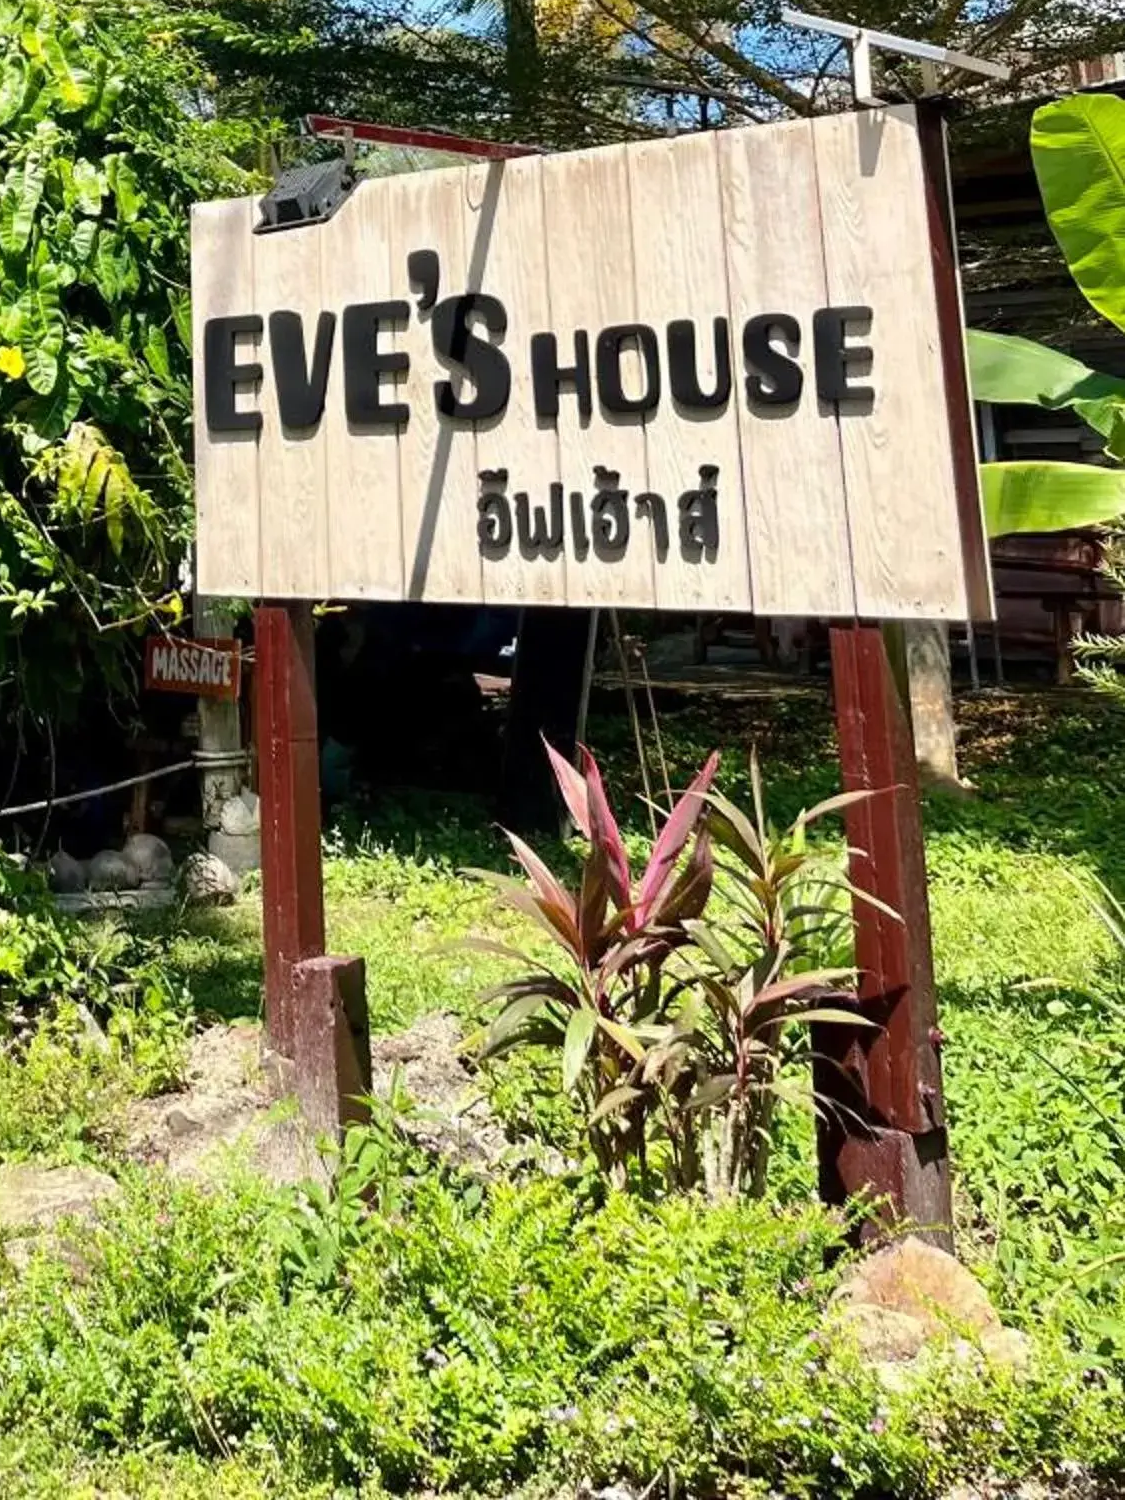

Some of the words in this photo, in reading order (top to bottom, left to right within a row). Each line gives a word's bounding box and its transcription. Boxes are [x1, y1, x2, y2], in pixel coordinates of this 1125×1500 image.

[204, 249, 511, 432] EVE'S
[530, 306, 876, 420] HOUSE
[152, 646, 232, 687] MASSAGE
